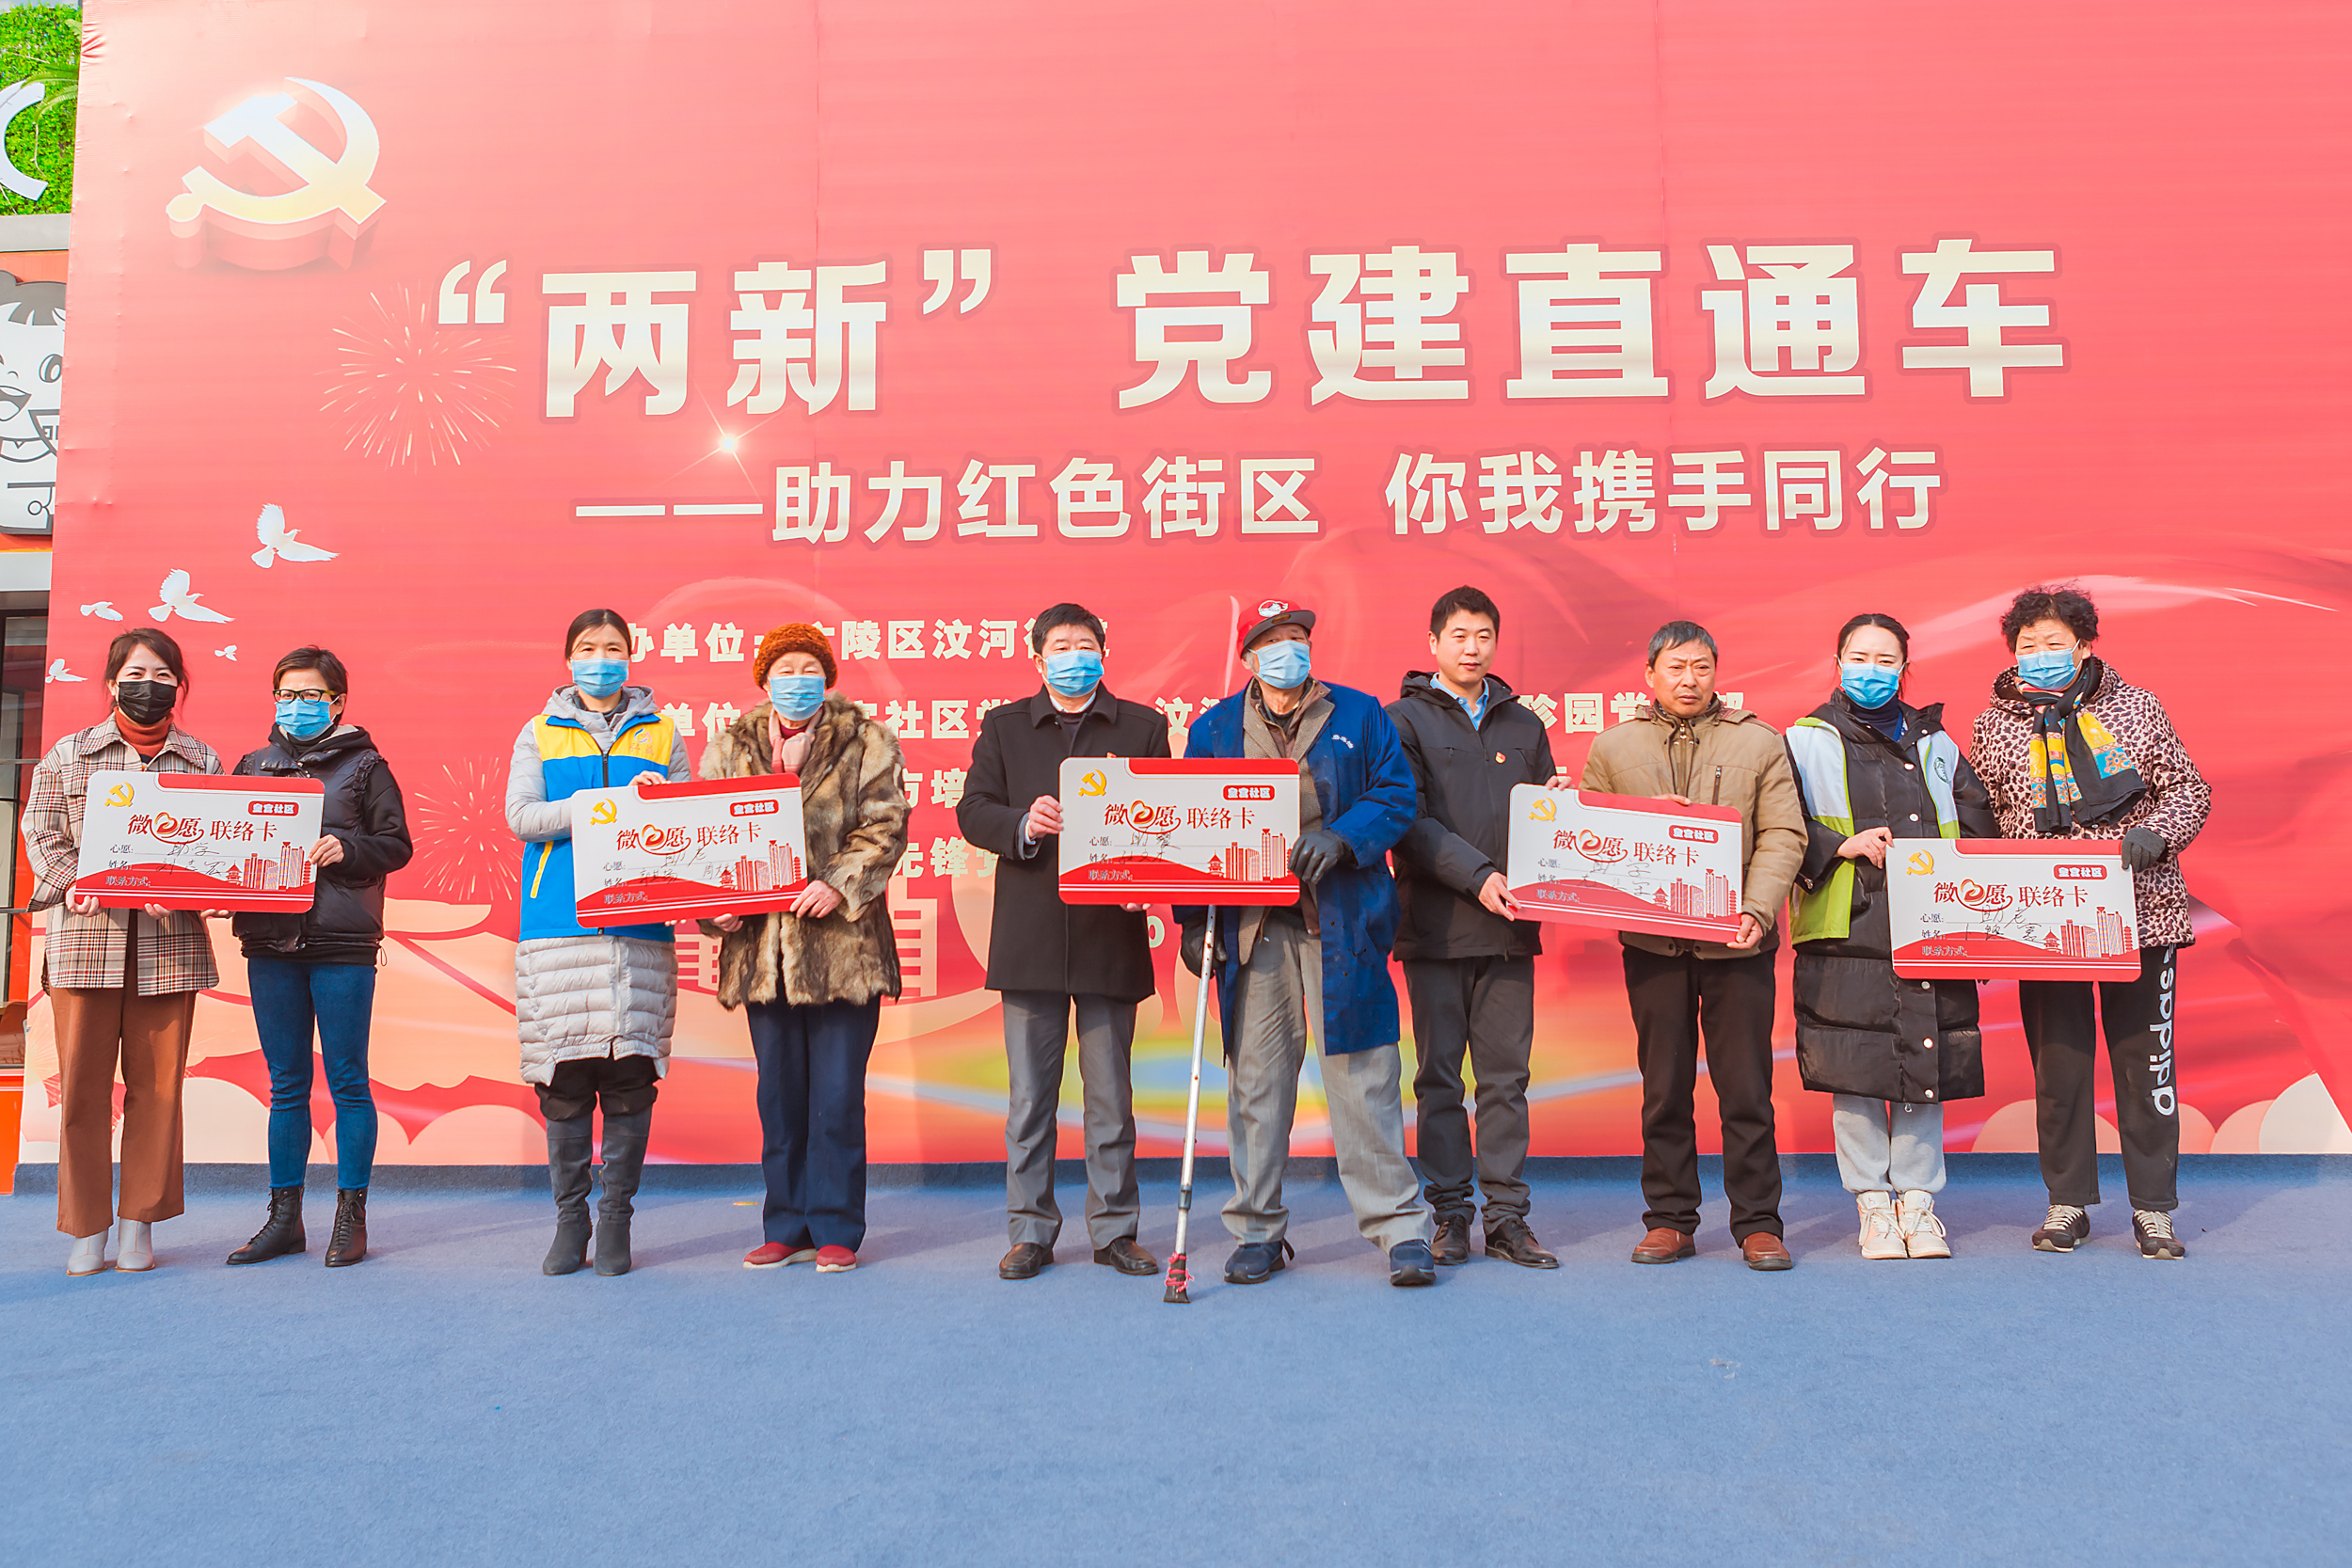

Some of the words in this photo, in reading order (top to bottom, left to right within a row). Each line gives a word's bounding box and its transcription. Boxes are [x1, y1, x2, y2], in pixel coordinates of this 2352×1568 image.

[1117, 239, 2063, 409] 党建直通车
[1385, 447, 1941, 535] 你我携手同行
[1186, 807, 1255, 830] 联络卡
[210, 820, 278, 842] 联络卡
[696, 822, 762, 846] 联络卡
[1633, 842, 1700, 867] 联络卡
[2018, 885, 2089, 908] 联络卡
[2149, 967, 2175, 1117] adidas
